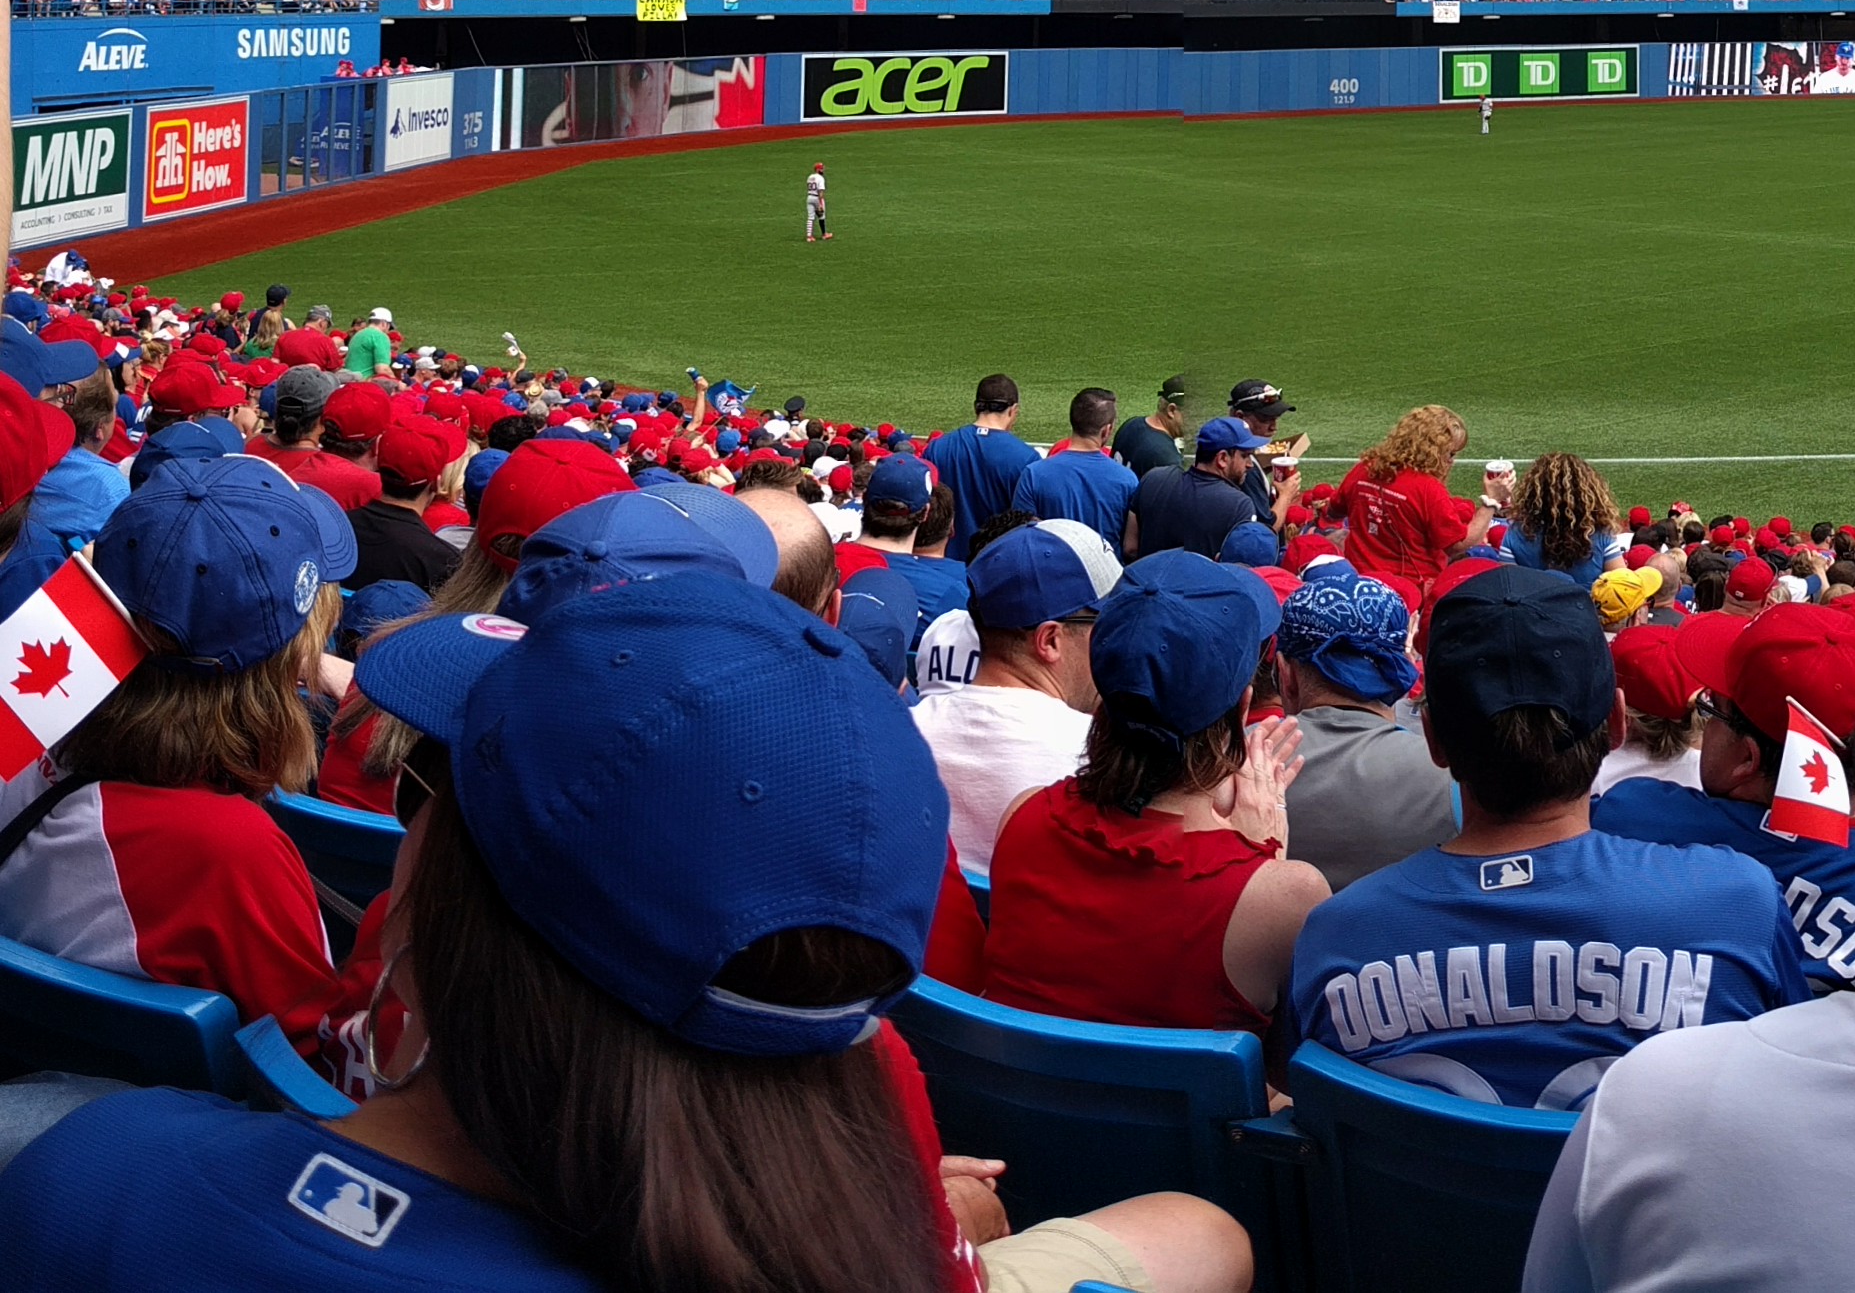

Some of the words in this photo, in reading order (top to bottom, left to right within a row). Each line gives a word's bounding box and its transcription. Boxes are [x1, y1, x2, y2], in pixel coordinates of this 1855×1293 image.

[238, 27, 350, 59] SAMSUNG
[821, 56, 990, 115] acer
[1330, 79, 1359, 94] 400
[1457, 61, 1488, 88] TD
[1524, 60, 1556, 85] TD
[1592, 59, 1622, 83] TD
[408, 107, 448, 132] Invesco
[463, 111, 483, 135] 375
[193, 119, 241, 155] Here's
[21, 128, 115, 205] MNP
[192, 162, 231, 193] How.
[20, 213, 55, 230] ACCOUNTING
[64, 207, 95, 221] CONSULTING
[1323, 939, 1714, 1054] DONALDSON
